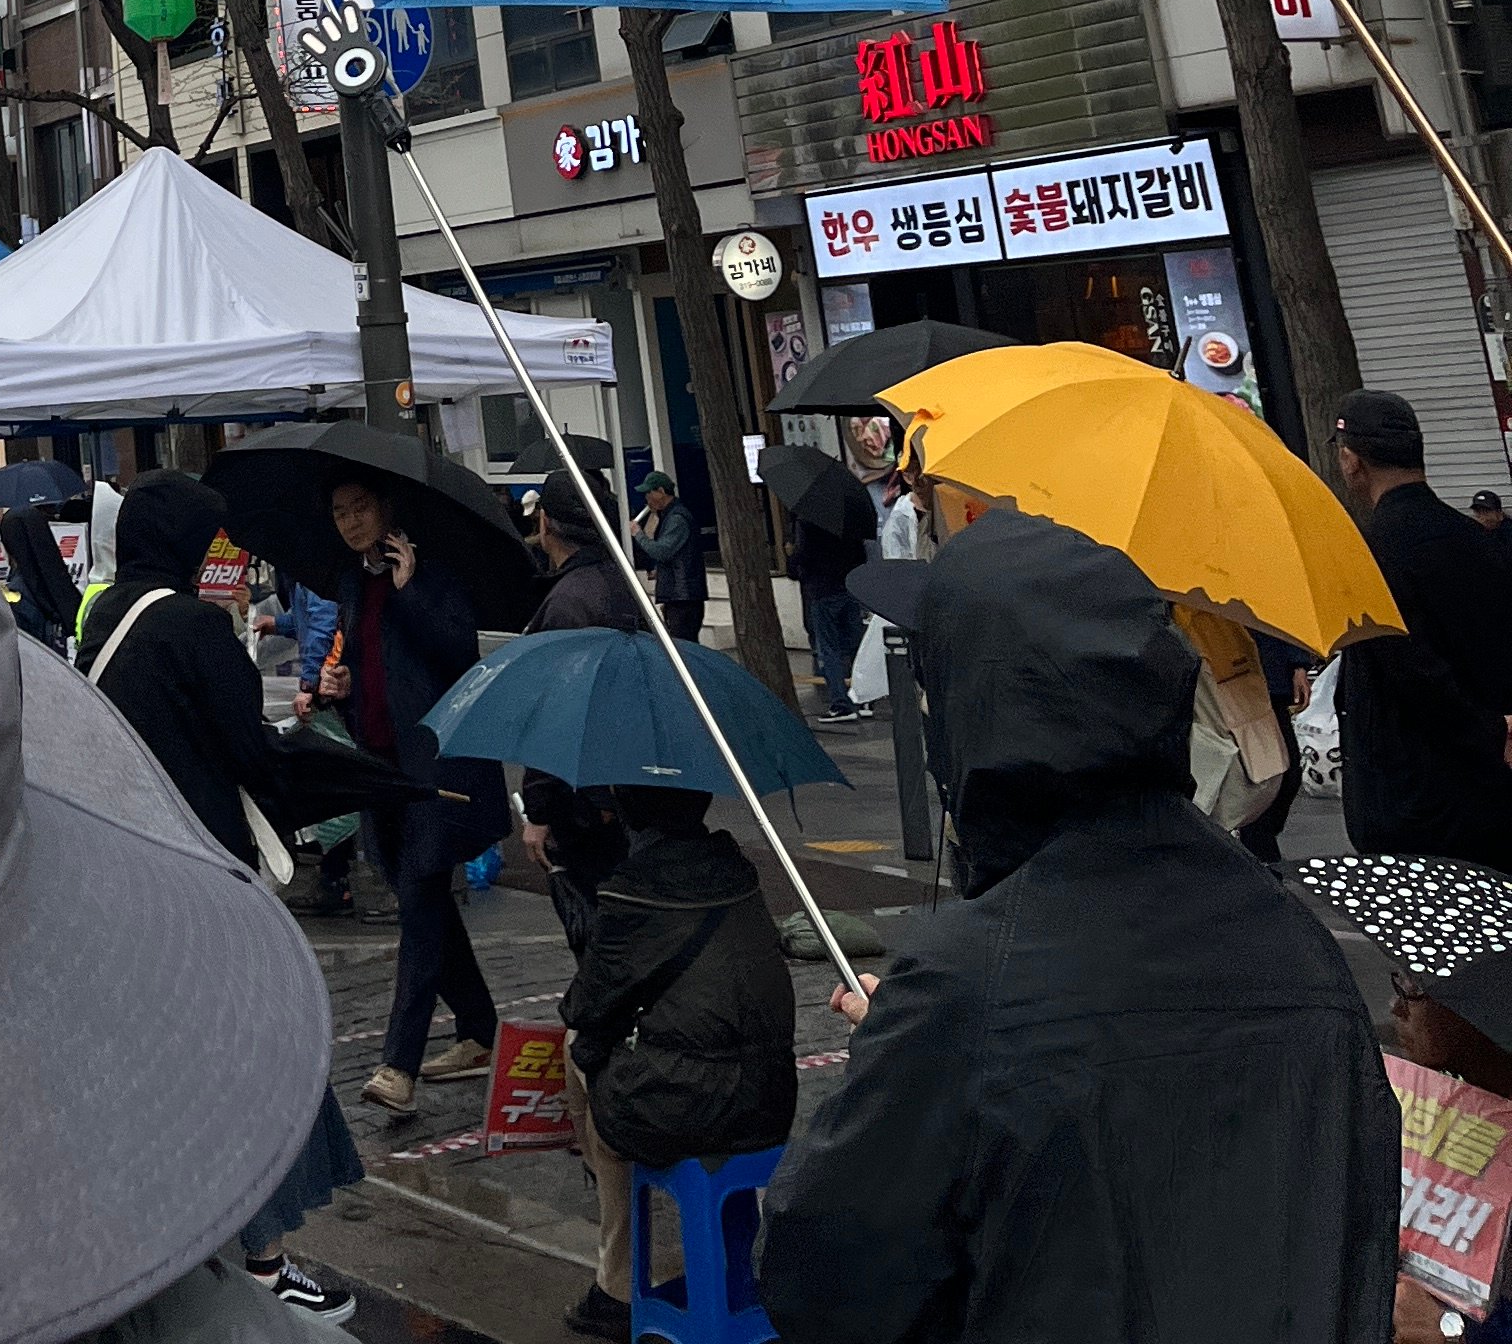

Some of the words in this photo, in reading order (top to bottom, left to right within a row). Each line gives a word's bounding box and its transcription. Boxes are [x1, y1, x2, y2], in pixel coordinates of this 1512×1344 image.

[856, 21, 985, 124] 紅山
[585, 114, 647, 171] 김가
[866, 115, 990, 163] HONGSAN
[821, 209, 880, 258] 한우
[891, 197, 985, 251] 생등심
[1004, 161, 1214, 237] 숯불돼지갈비
[728, 256, 776, 280] 김가네
